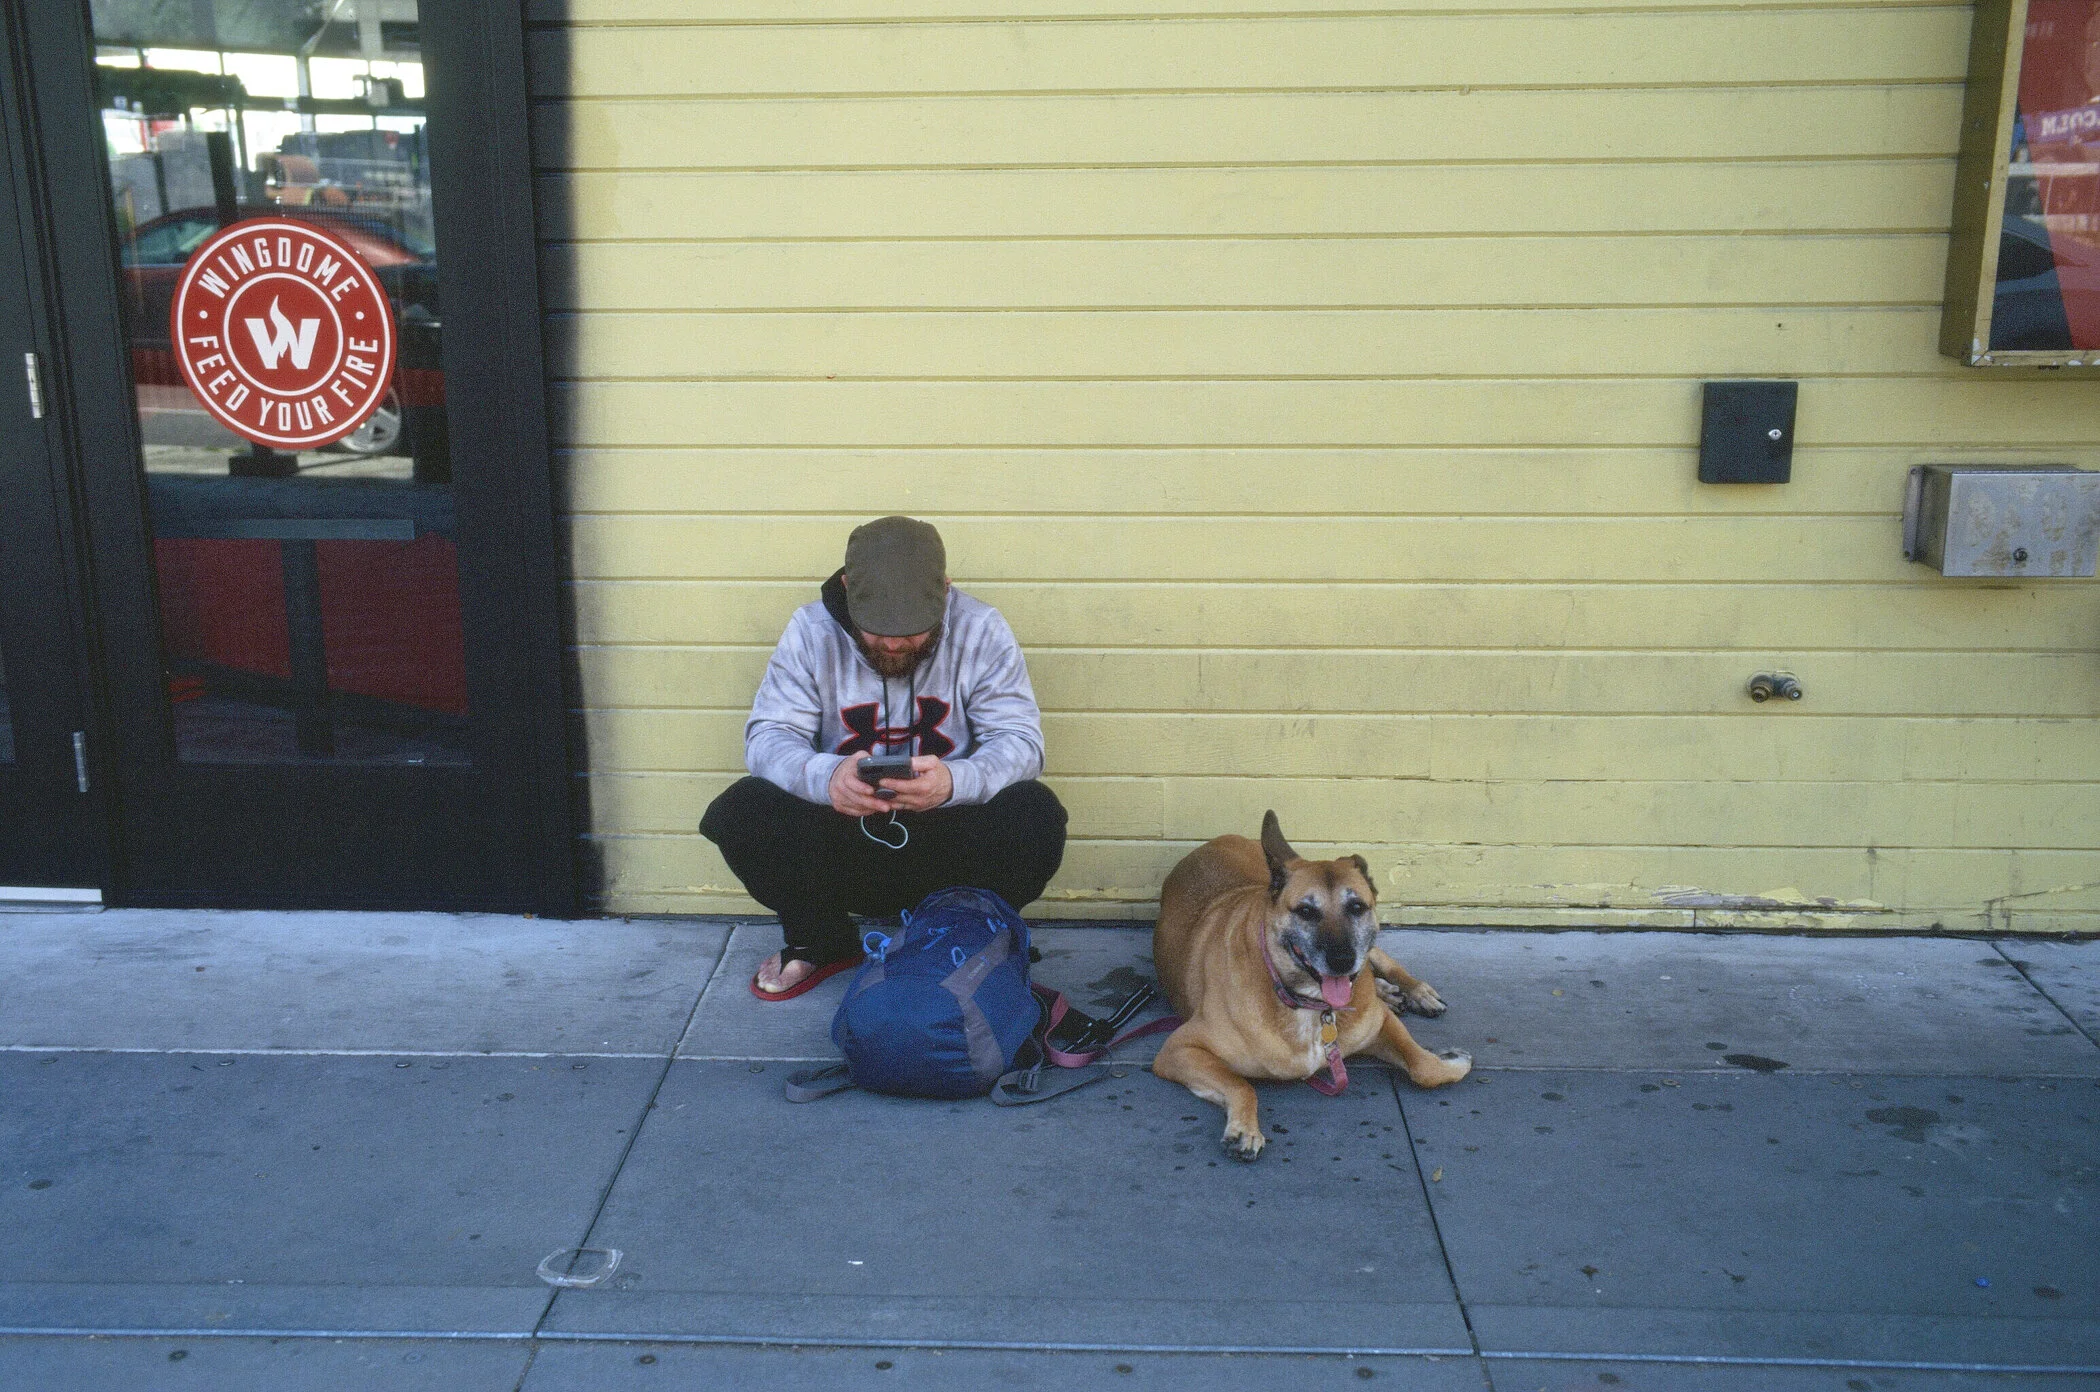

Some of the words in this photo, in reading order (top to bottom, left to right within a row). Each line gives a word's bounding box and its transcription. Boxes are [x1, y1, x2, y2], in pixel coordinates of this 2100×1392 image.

[198, 237, 360, 302] WINGDOME
[189, 335, 250, 412] FEED
[259, 395, 334, 431] YOUR
[330, 336, 379, 408] FIRE
